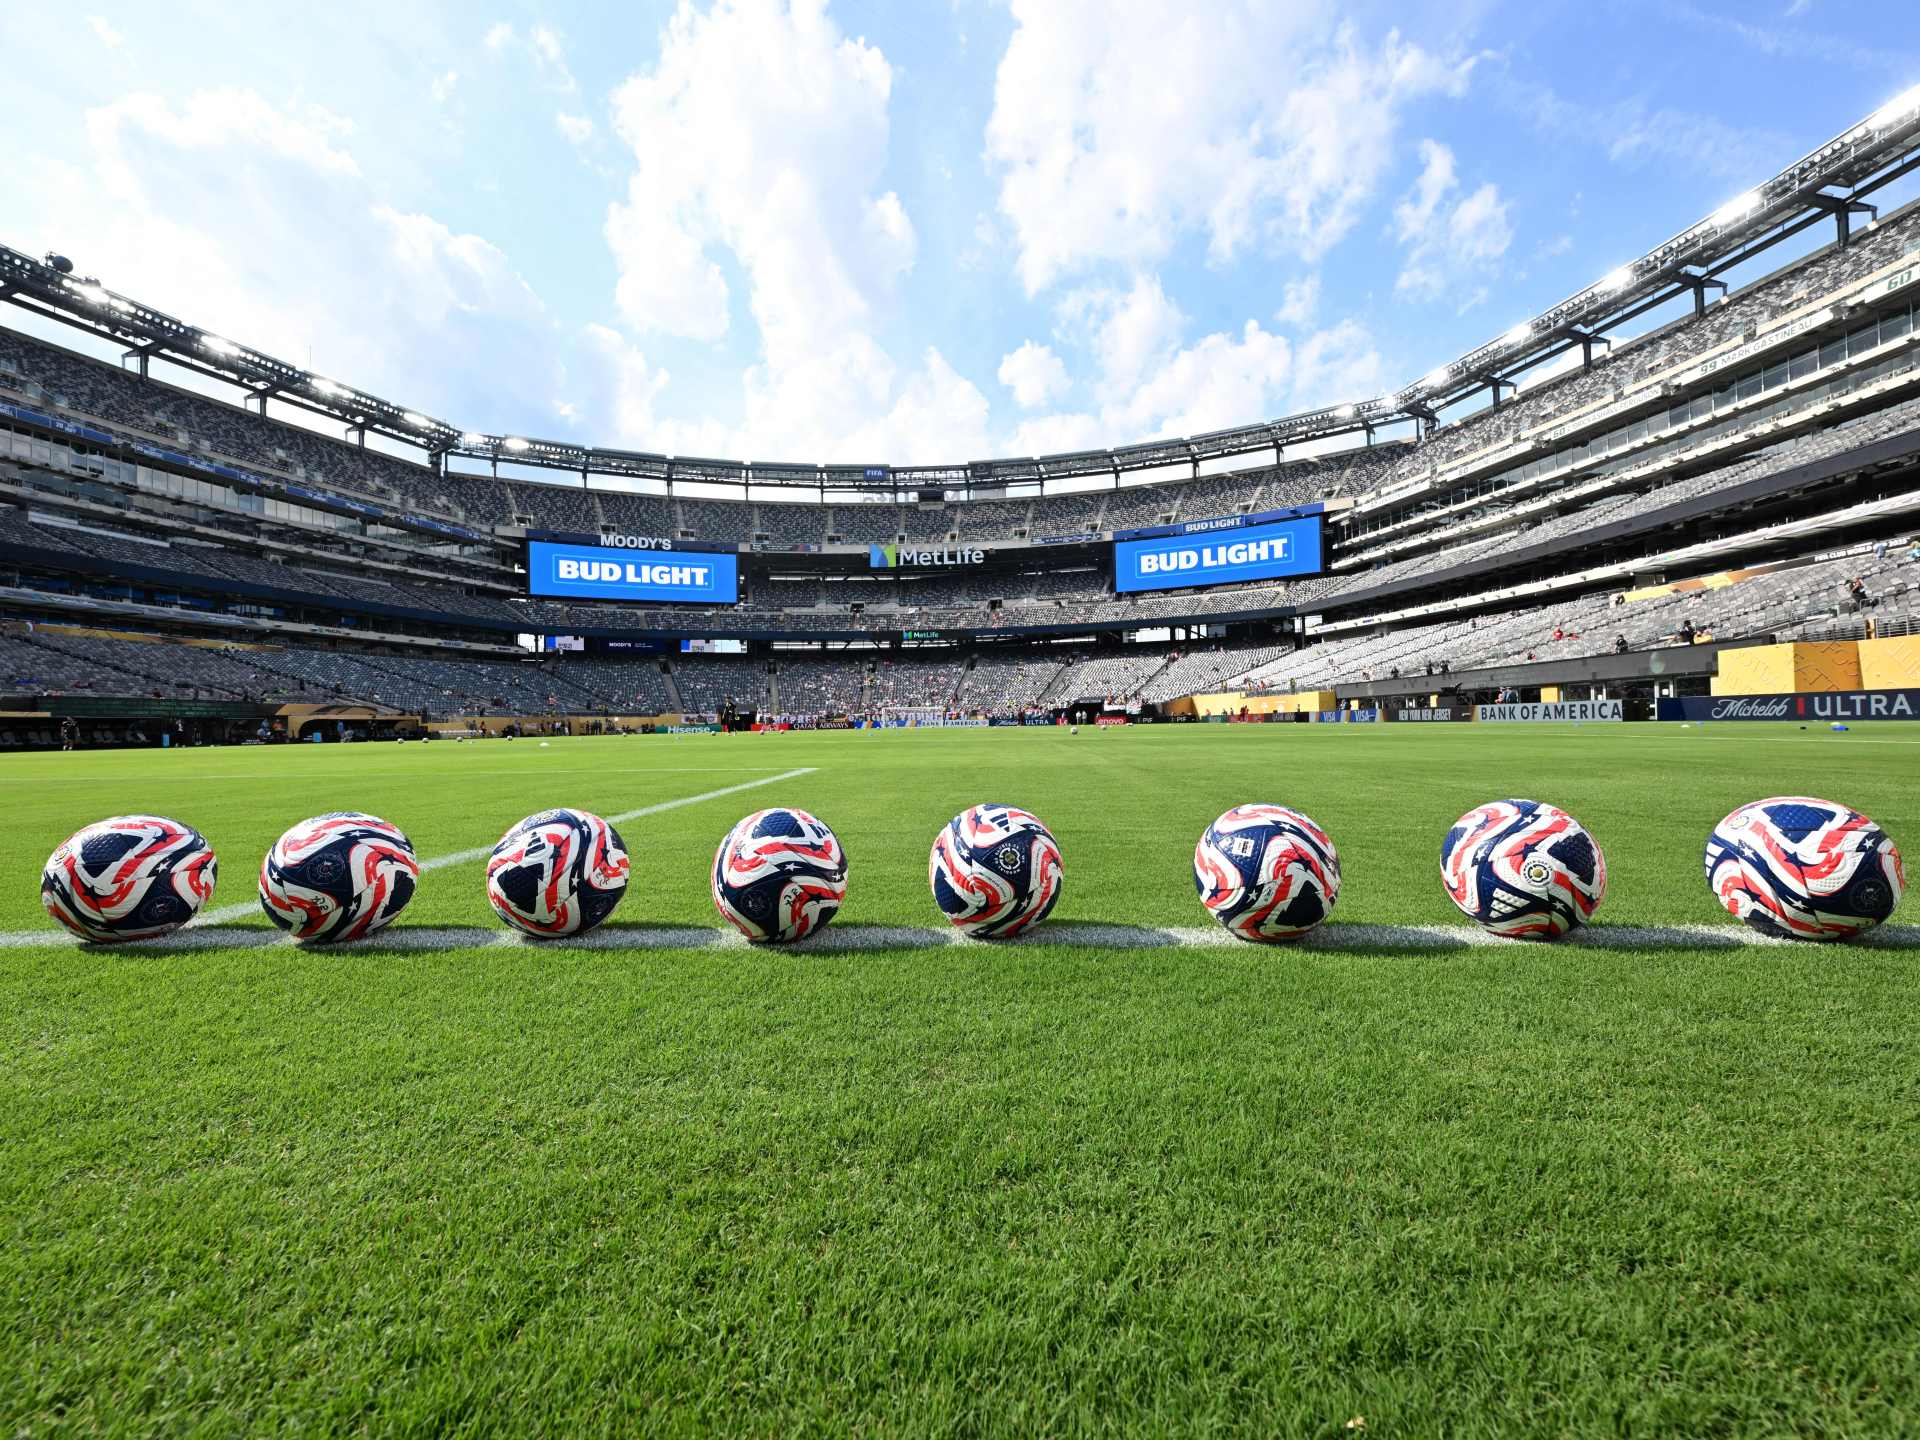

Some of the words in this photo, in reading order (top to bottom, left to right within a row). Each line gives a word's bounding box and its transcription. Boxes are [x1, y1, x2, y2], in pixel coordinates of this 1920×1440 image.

[1700, 360, 1717, 375] 99
[1721, 348, 1751, 365] MARK
[1185, 522, 1209, 532] BUD
[1209, 516, 1242, 530] LIGHT
[600, 534, 672, 551] MOODY'S
[900, 548, 984, 566] MetLife
[1140, 549, 1199, 573] BUD
[1203, 538, 1288, 567] LIGHT
[559, 559, 622, 581] BUD
[626, 564, 708, 586] LIGHT
[1433, 708, 1451, 720] JERSEY
[1481, 705, 1516, 721] BANK
[1520, 704, 1538, 720] OF
[1542, 701, 1622, 720] AMERICA
[1712, 697, 1791, 719] Michelob
[1814, 693, 1914, 716] ULTRA
[667, 725, 711, 734] Hisense
[820, 721, 849, 729] AIRWAYS
